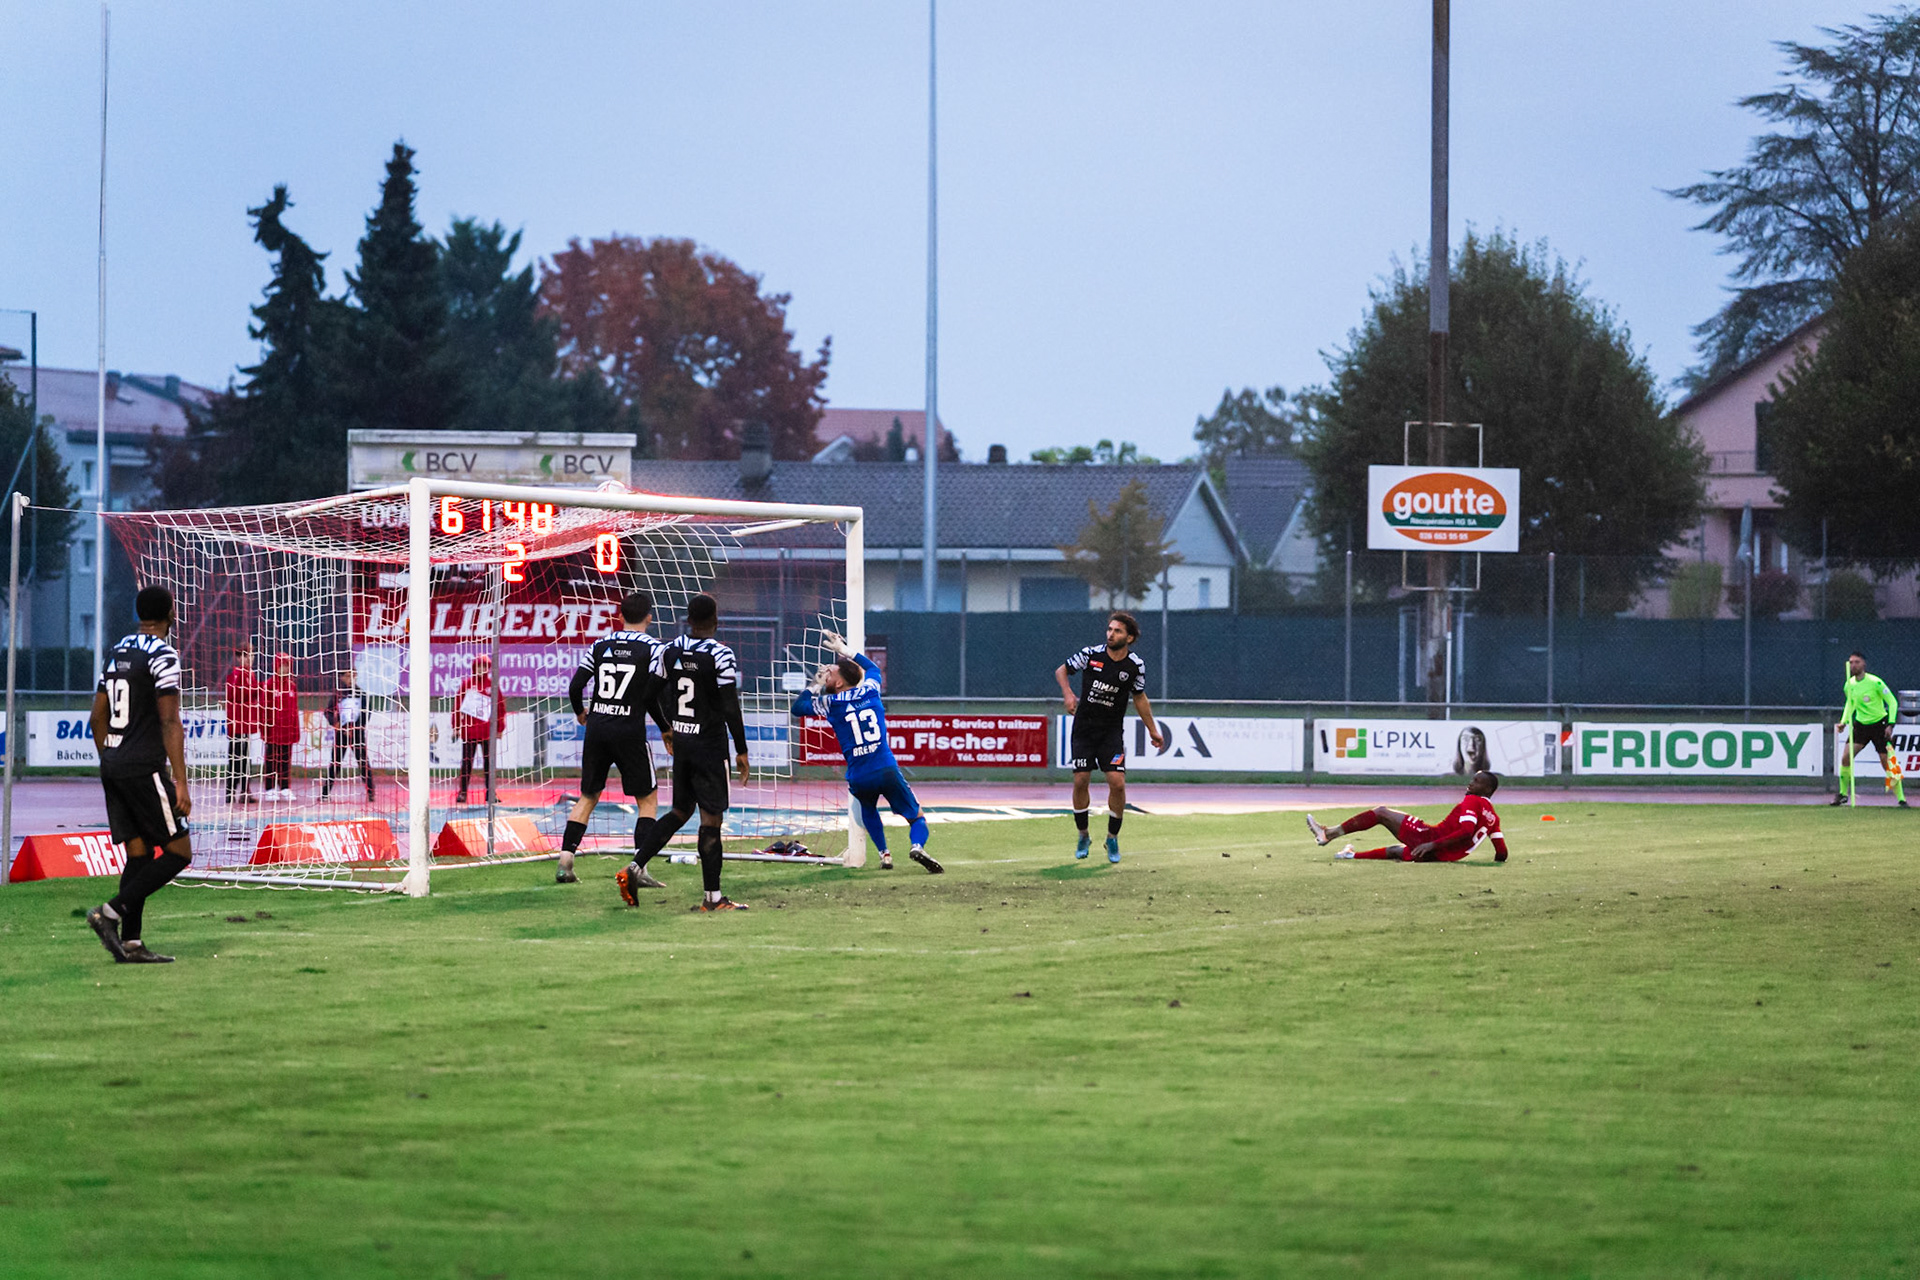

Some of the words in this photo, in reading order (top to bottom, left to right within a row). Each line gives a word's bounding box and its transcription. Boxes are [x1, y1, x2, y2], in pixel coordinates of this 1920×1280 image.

[426, 453, 477, 473] BCV
[563, 454, 614, 475] BCV
[1392, 488, 1495, 520] goutte
[504, 542, 526, 582] 2
[596, 533, 619, 573] 0
[597, 663, 636, 700] 67
[677, 677, 695, 717] 2
[105, 679, 130, 730] 19
[592, 703, 631, 716] AHMETAJ
[845, 708, 882, 746] 13
[914, 732, 1008, 750] Fischer
[952, 719, 996, 729] Service
[998, 719, 1042, 730] traiteur
[1582, 730, 1811, 769] FRICOPY
